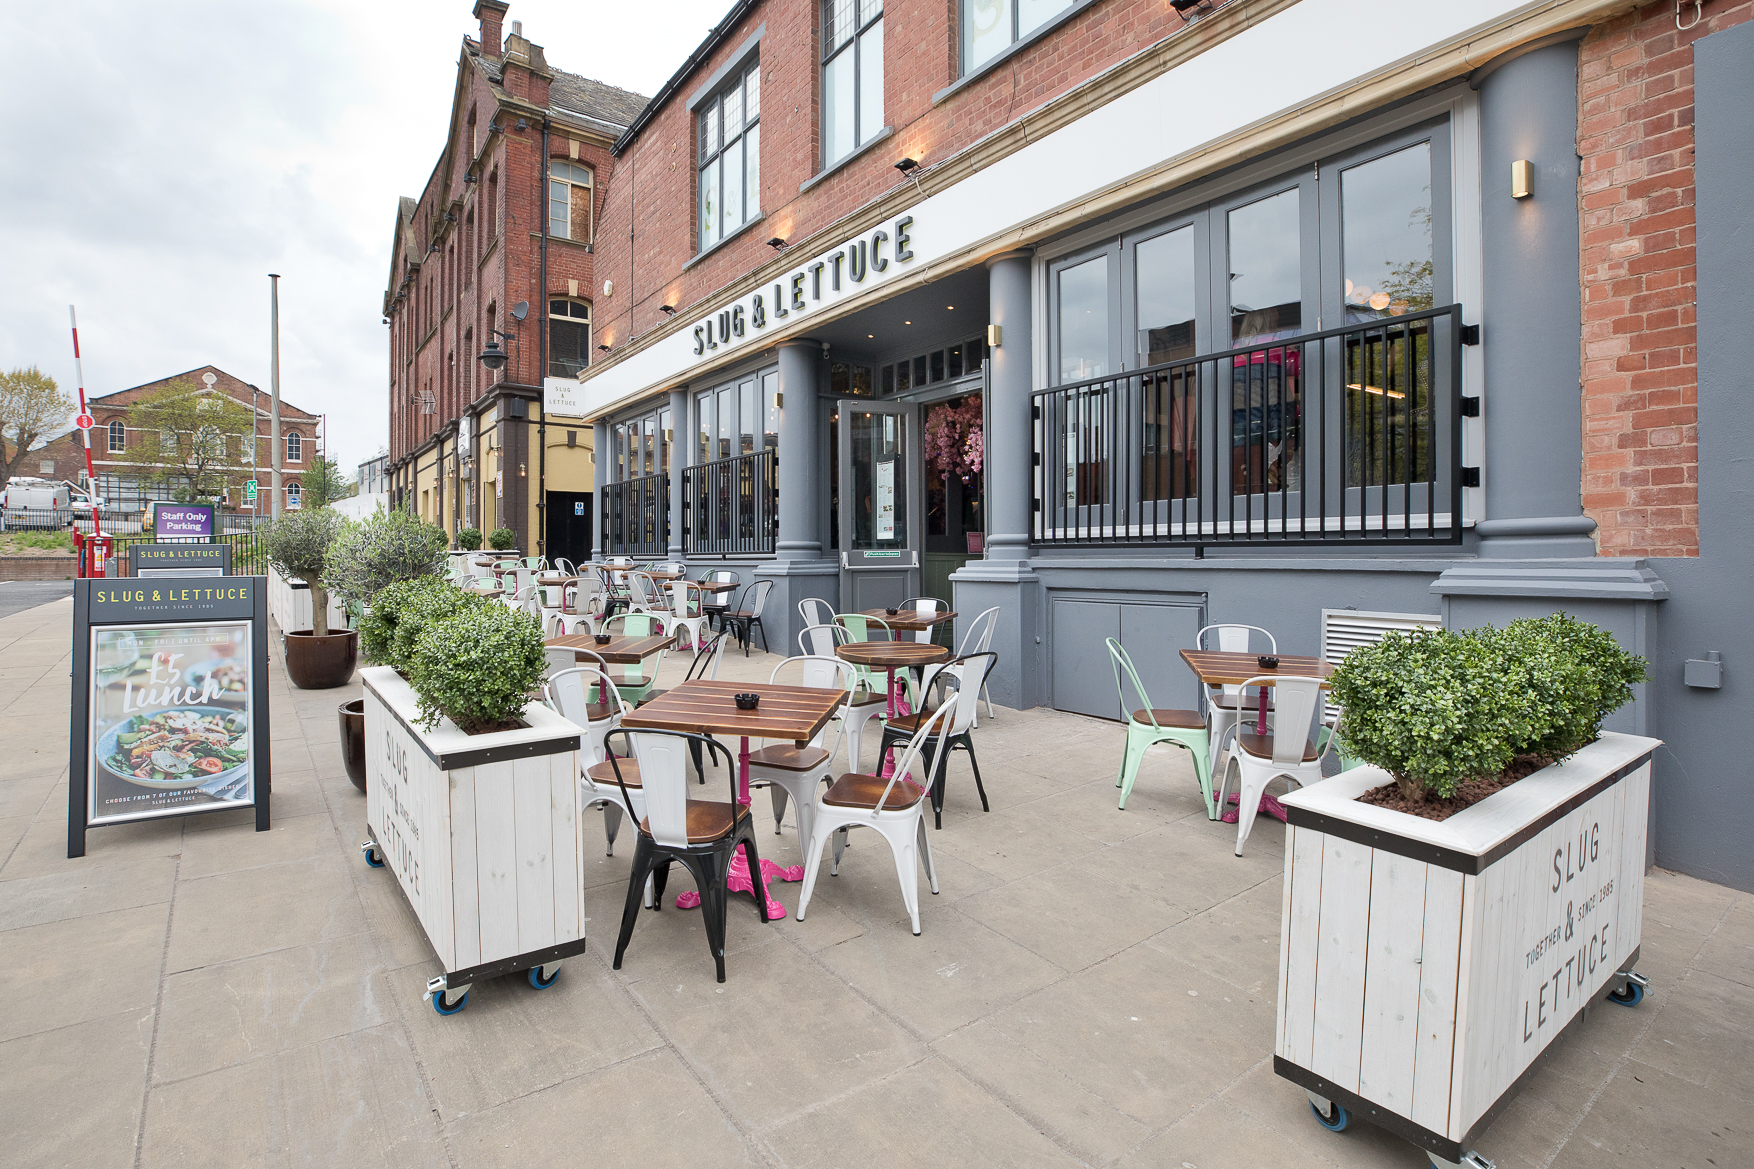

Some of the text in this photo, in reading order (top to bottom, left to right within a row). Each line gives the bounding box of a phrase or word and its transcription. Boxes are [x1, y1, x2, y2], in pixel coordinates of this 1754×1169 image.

[692, 215, 914, 356] SLUG & LETTUCE
[162, 512, 207, 522] Staff Only
[166, 522, 202, 532] Parking
[97, 588, 248, 602] SLUG & LETTUCE
[146, 652, 184, 685] £5
[123, 670, 226, 714] Lunch
[386, 730, 408, 785] SLUG
[105, 796, 130, 804] CHOOSE
[394, 783, 398, 816] &
[382, 806, 420, 896] LETTUCE
[1552, 822, 1598, 893] SLUG
[1526, 878, 1614, 970] TOGETHER & SINCE 1985
[1524, 922, 1609, 1044] LETTUCE
